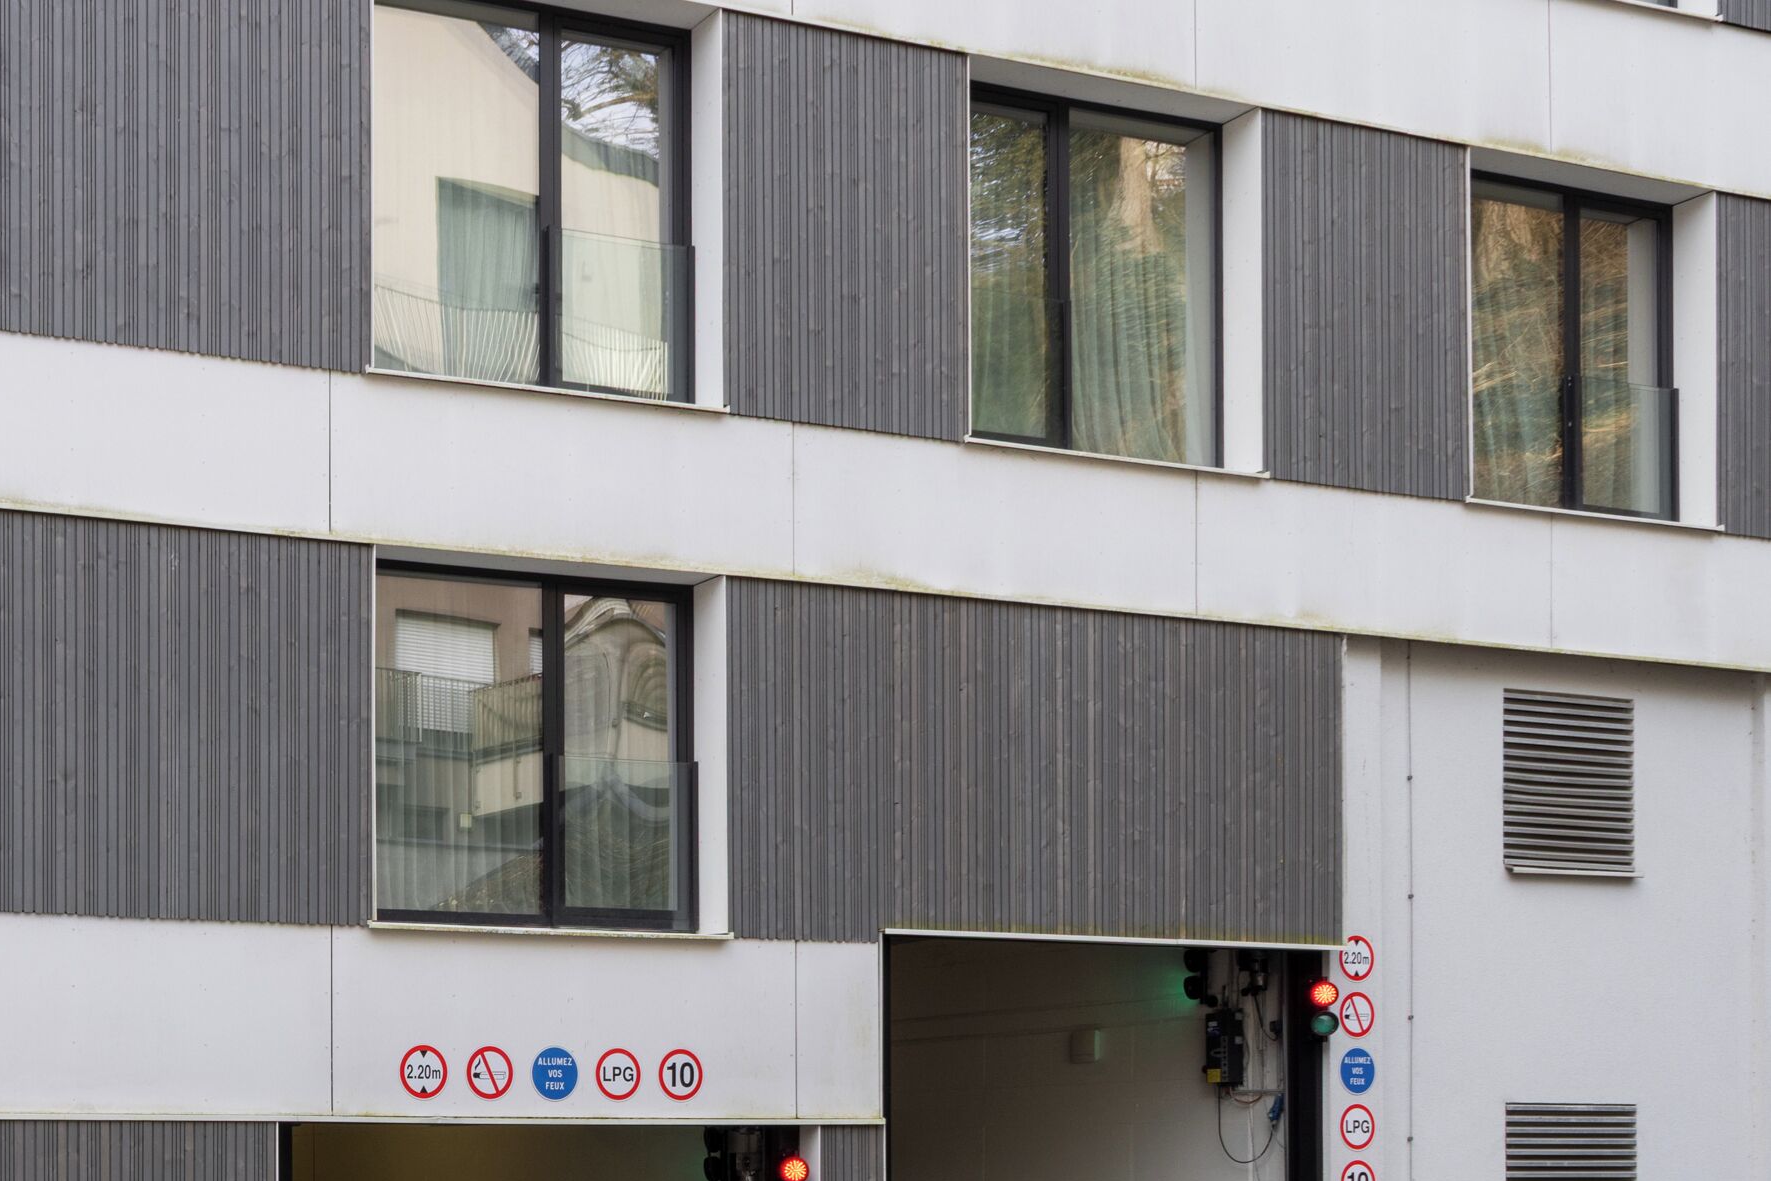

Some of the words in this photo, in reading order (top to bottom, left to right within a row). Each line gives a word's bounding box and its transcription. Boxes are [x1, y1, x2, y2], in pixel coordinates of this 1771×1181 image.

[1344, 952, 1370, 965] 2.20m
[537, 1057, 573, 1066] ALLUMEZ
[1344, 1056, 1371, 1065] ALLUMEZ
[406, 1065, 441, 1080] 2.20m
[547, 1069, 563, 1078] VOS
[602, 1067, 634, 1082] LPG
[667, 1062, 695, 1087] 10
[545, 1082, 565, 1090] FEUX
[1345, 1120, 1370, 1134] LPG
